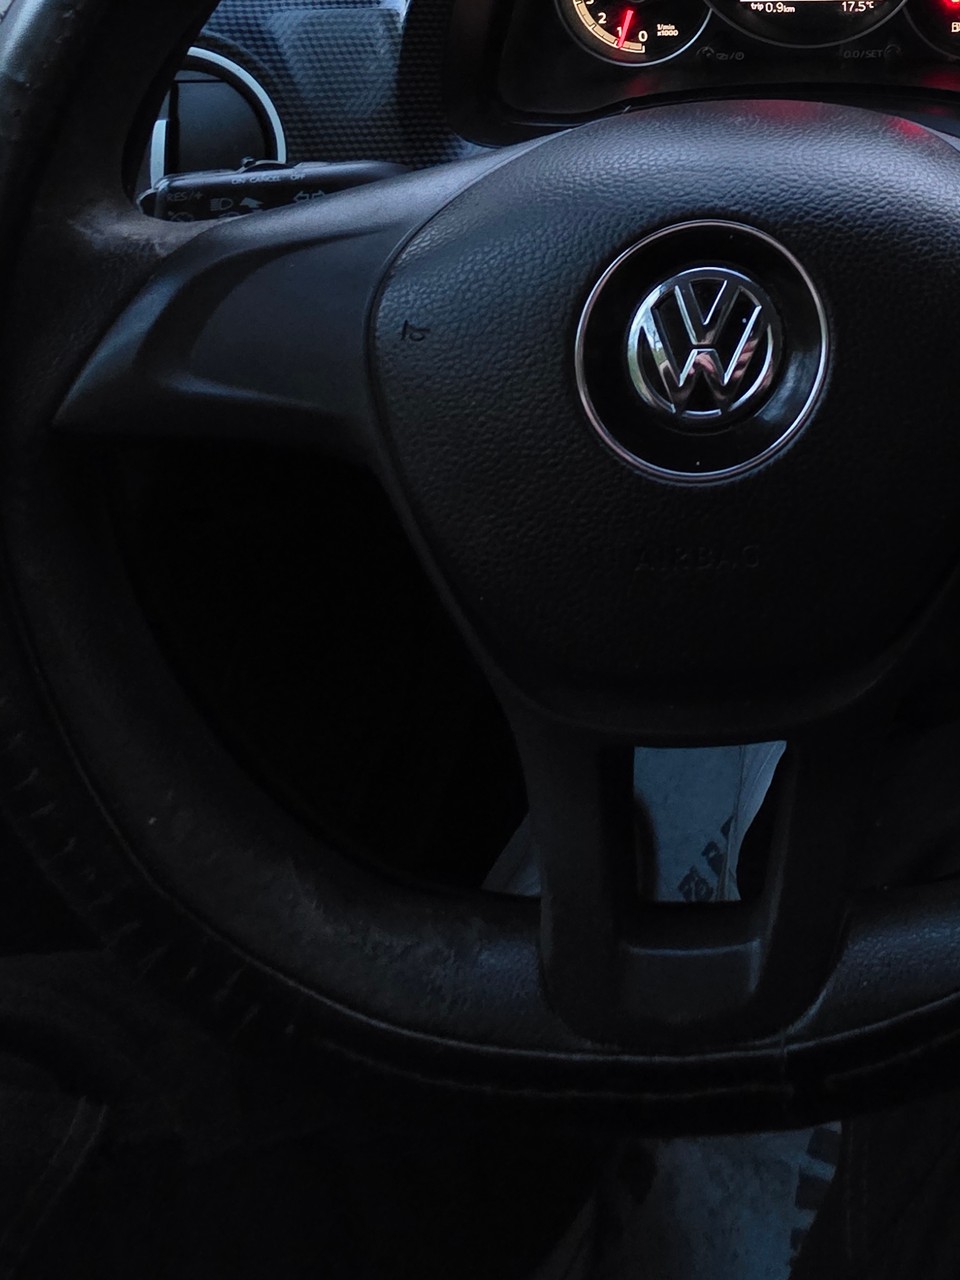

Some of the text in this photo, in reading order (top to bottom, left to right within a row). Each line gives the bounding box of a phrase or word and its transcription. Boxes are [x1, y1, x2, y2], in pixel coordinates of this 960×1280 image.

[750, 2, 764, 12] trip
[597, 12, 607, 24] 2
[638, 30, 648, 42] 0
